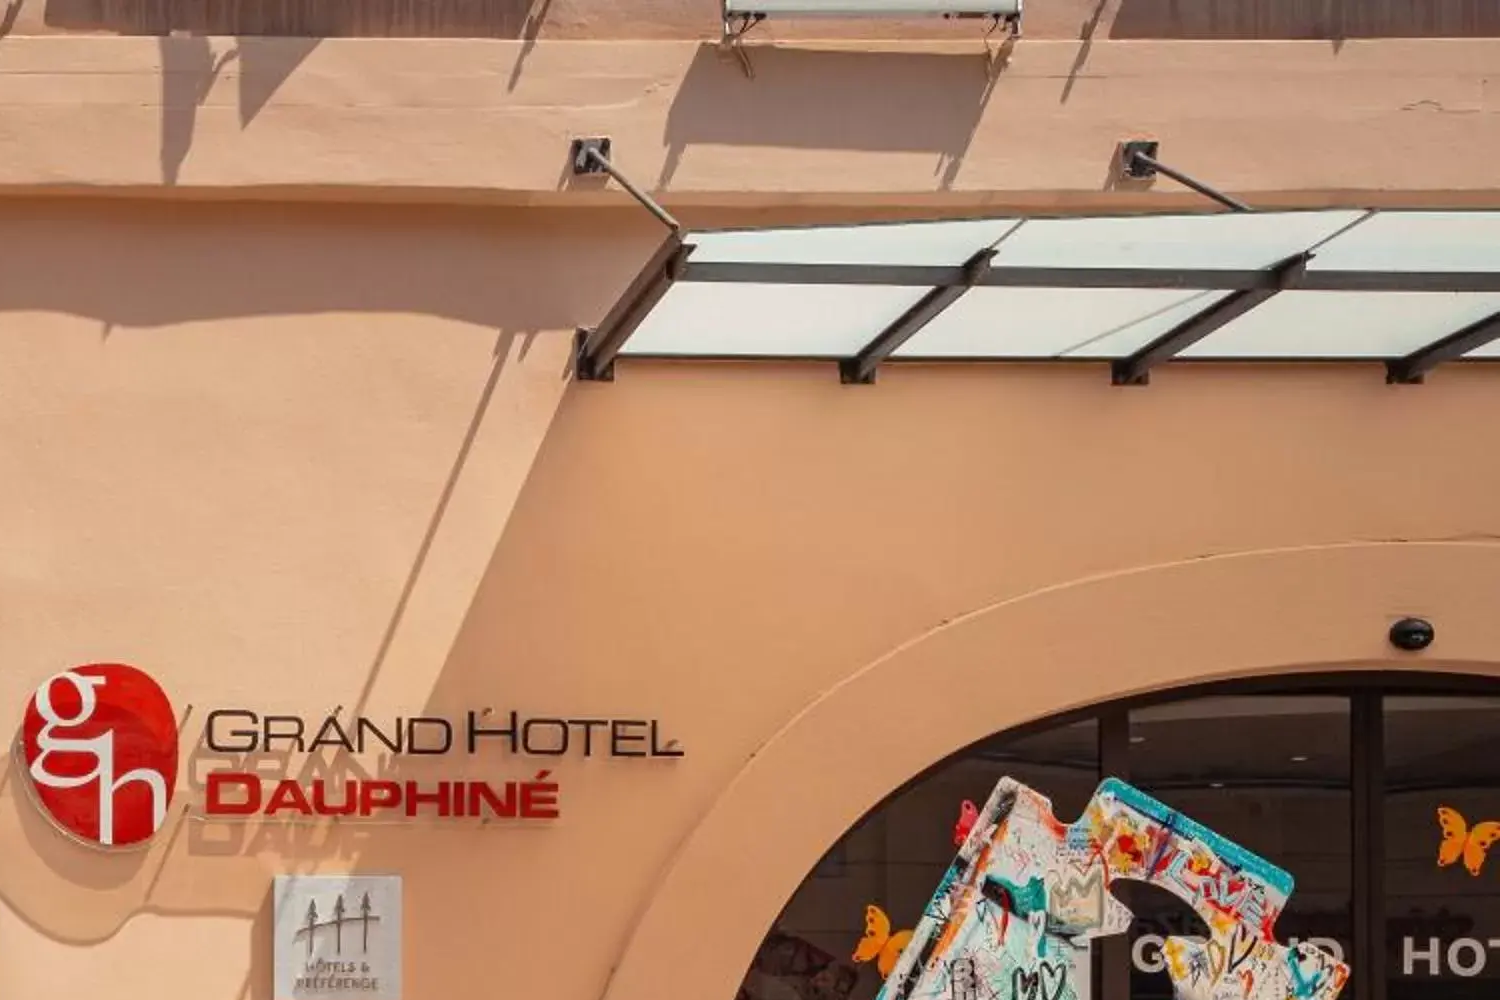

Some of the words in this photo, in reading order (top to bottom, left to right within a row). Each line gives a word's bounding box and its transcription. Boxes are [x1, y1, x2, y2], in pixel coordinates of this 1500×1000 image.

[206, 709, 452, 755] GRAND
[467, 710, 684, 759] HOTEL
[206, 769, 560, 819] DAUPHINÉ
[360, 961, 371, 973] &
